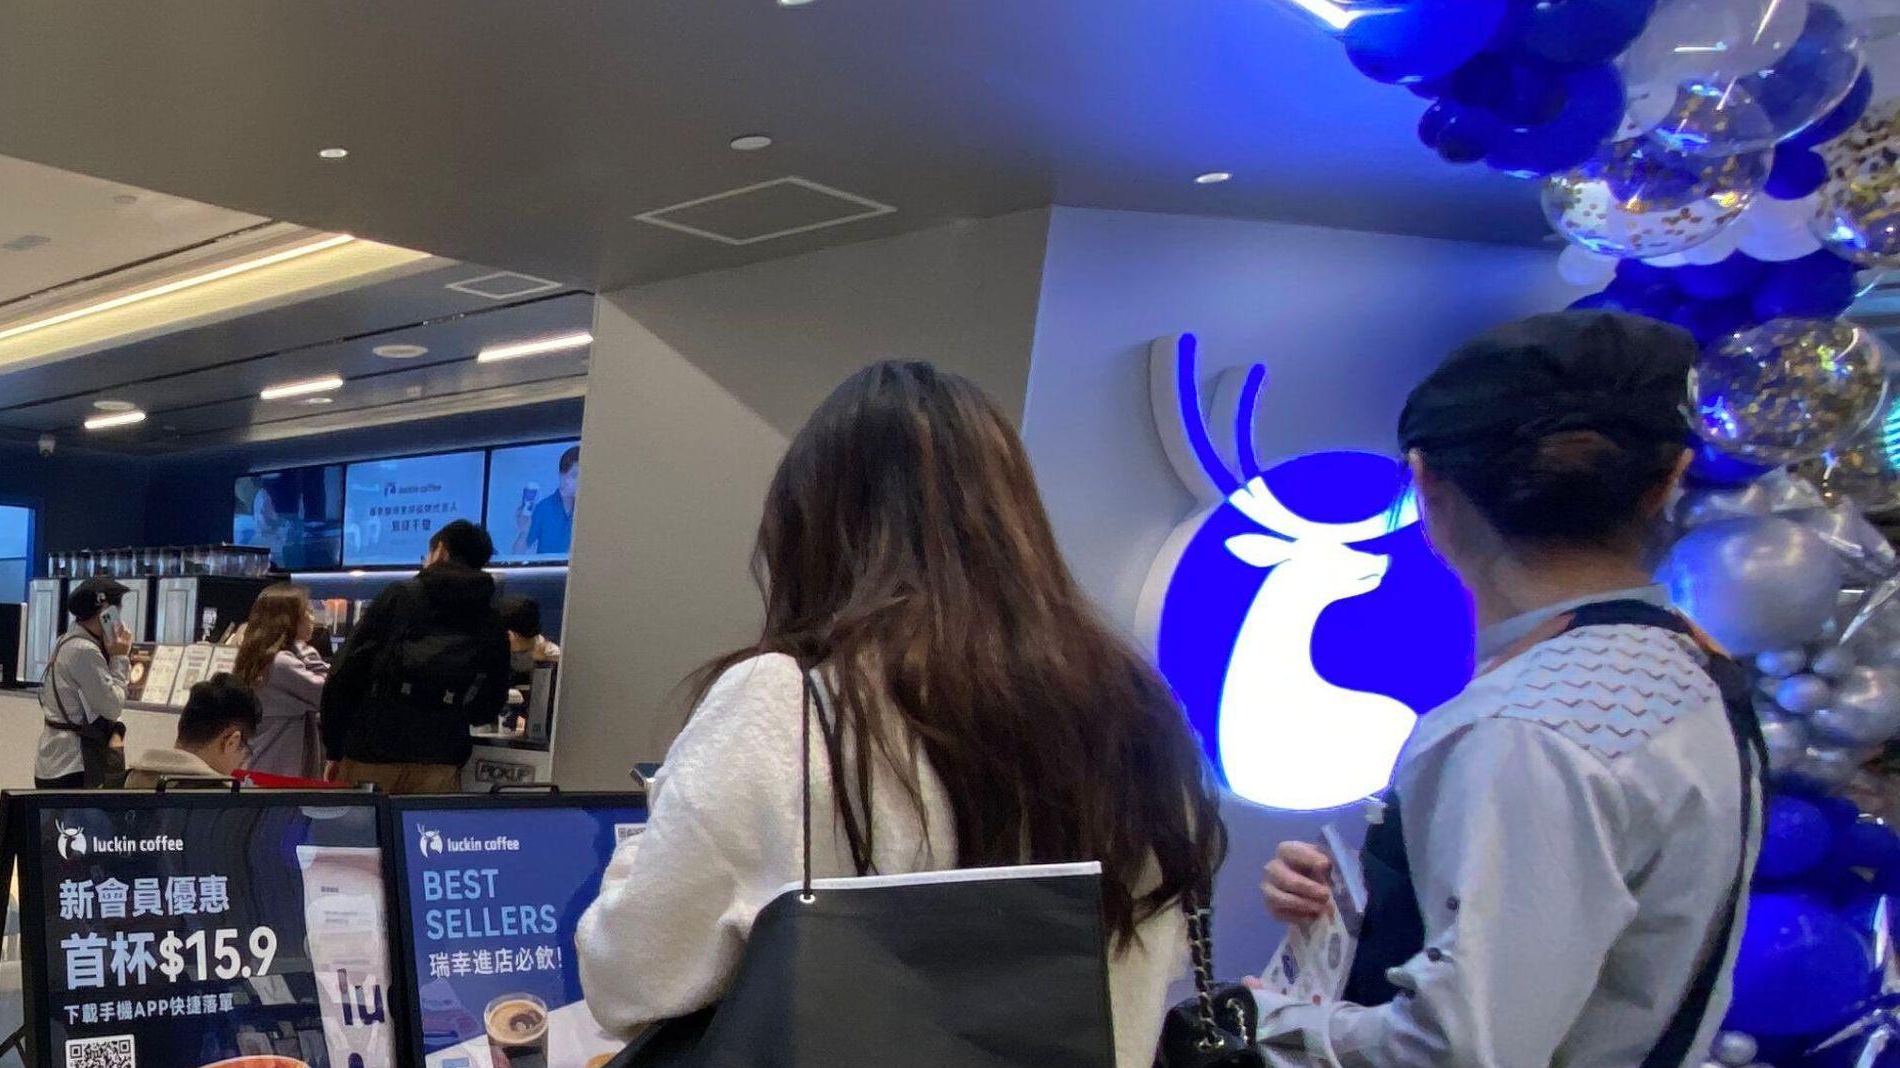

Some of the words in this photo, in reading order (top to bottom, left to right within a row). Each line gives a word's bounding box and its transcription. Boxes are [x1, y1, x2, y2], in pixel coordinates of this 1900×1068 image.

[92, 834, 136, 853] luckin
[139, 834, 184, 852] coffee
[447, 836, 482, 852] luckin
[484, 835, 520, 851] coffee
[59, 874, 230, 920] 新會員優惠
[423, 868, 499, 900] BEST
[426, 904, 558, 940] SELLERS
